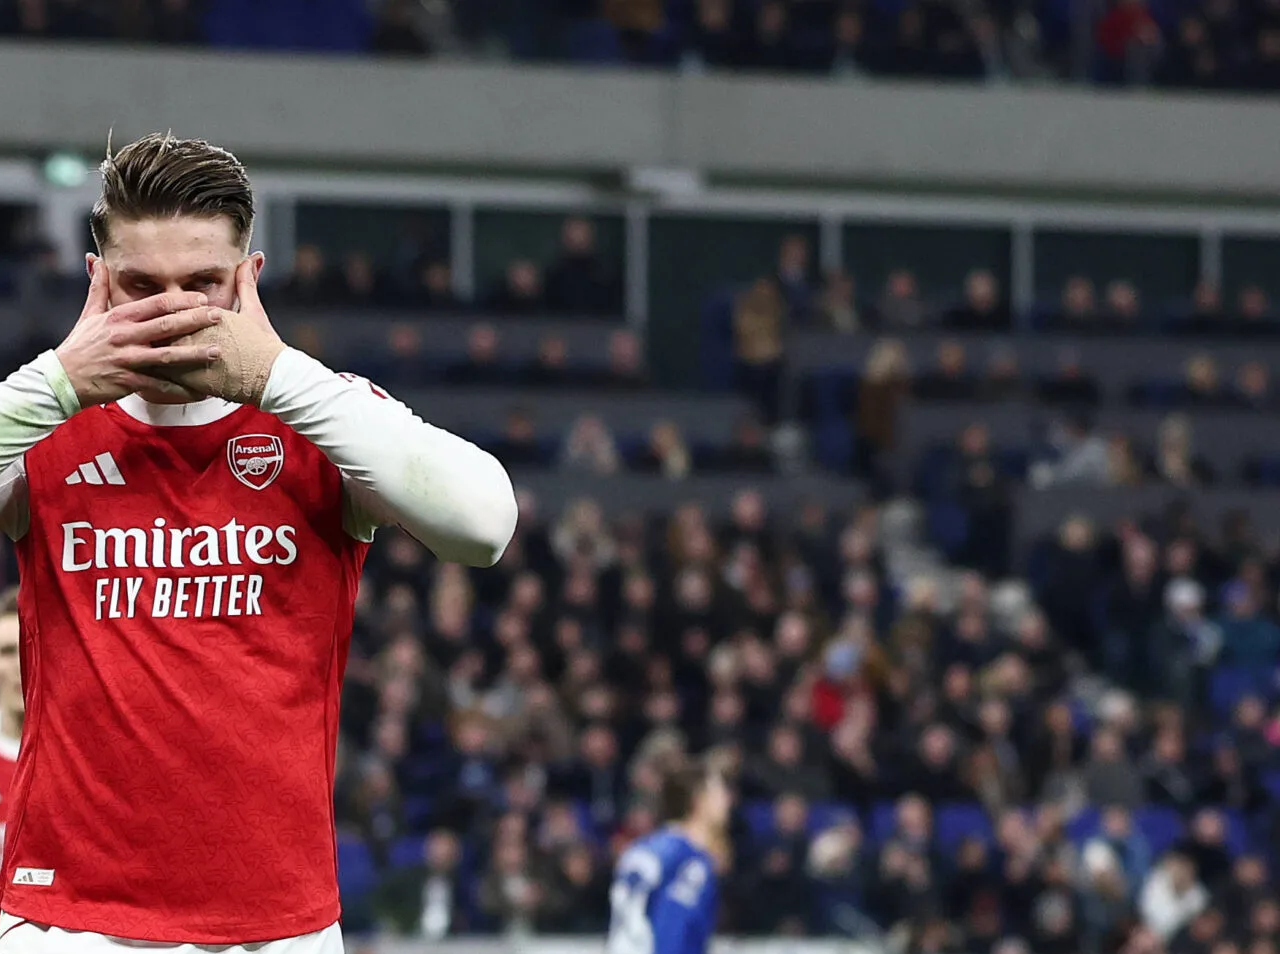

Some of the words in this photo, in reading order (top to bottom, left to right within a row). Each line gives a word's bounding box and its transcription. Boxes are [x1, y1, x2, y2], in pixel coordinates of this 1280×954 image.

[235, 443, 275, 454] Arsenal
[61, 517, 297, 572] Emirates
[95, 576, 145, 620] FLY
[151, 574, 263, 618] BETTER
